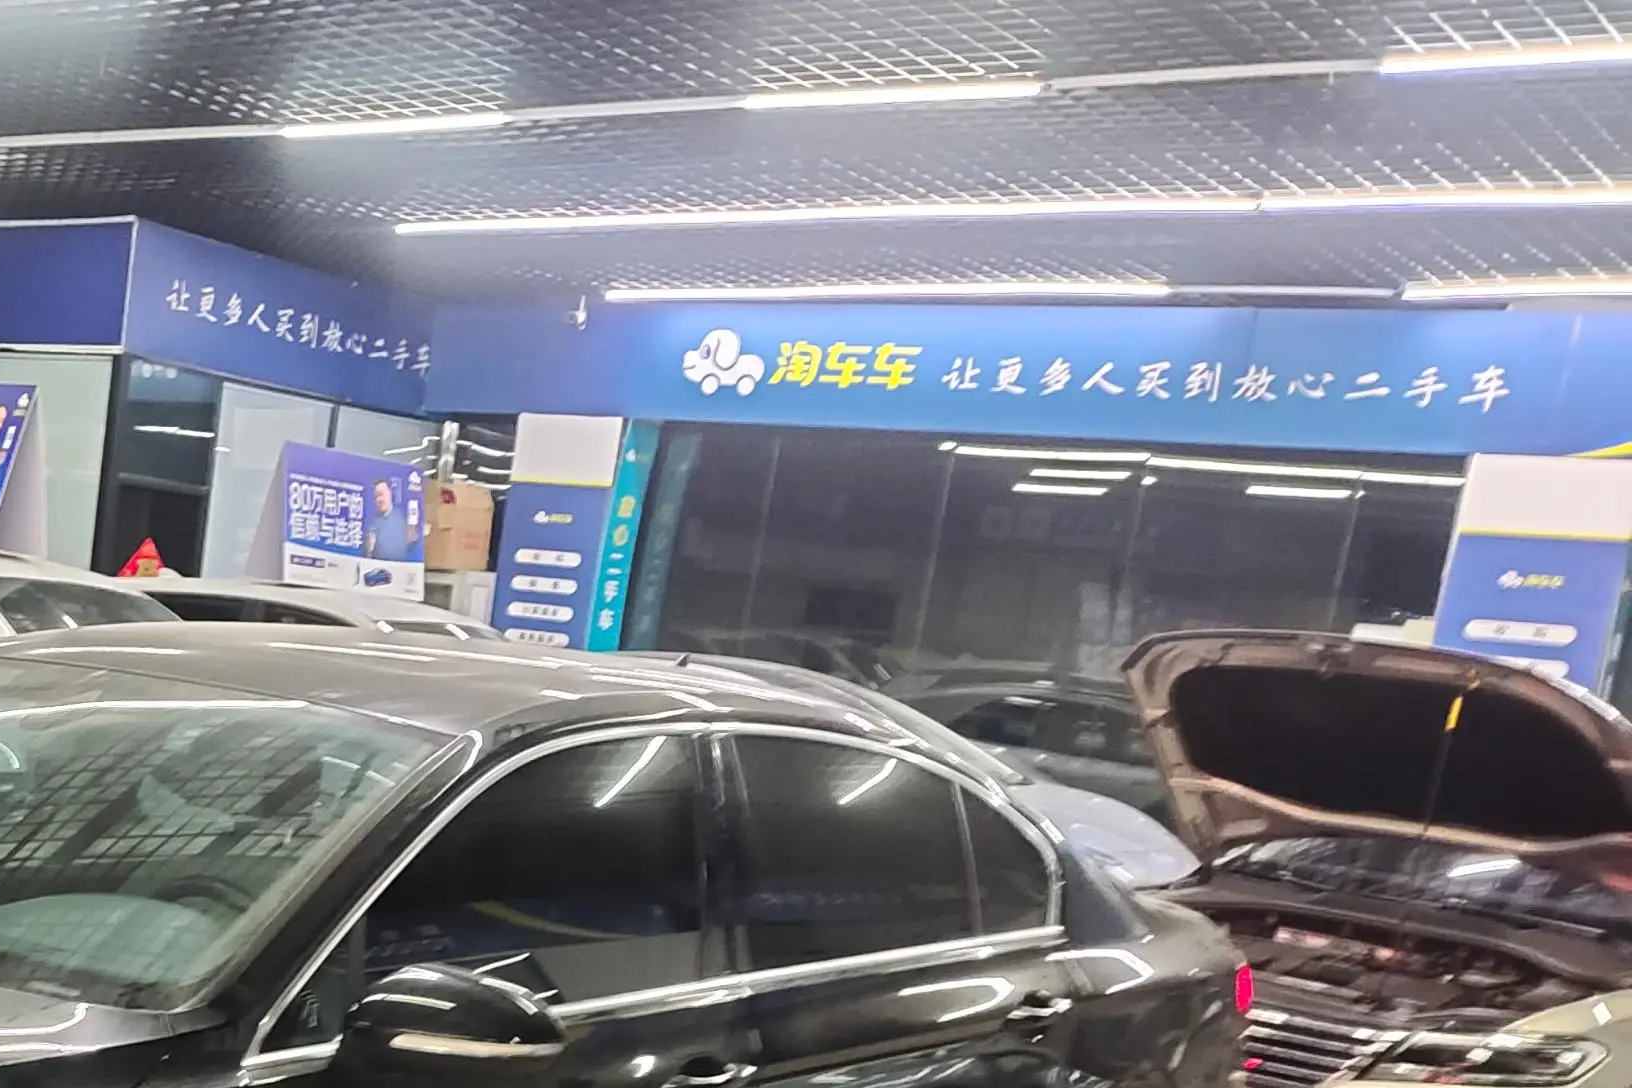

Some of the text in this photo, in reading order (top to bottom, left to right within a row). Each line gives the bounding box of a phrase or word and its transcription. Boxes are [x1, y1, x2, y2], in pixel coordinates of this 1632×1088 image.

[166, 278, 432, 378] 让更多人买到放心二手车
[768, 340, 1511, 412] 淘车车 让更多人买到放心二手车
